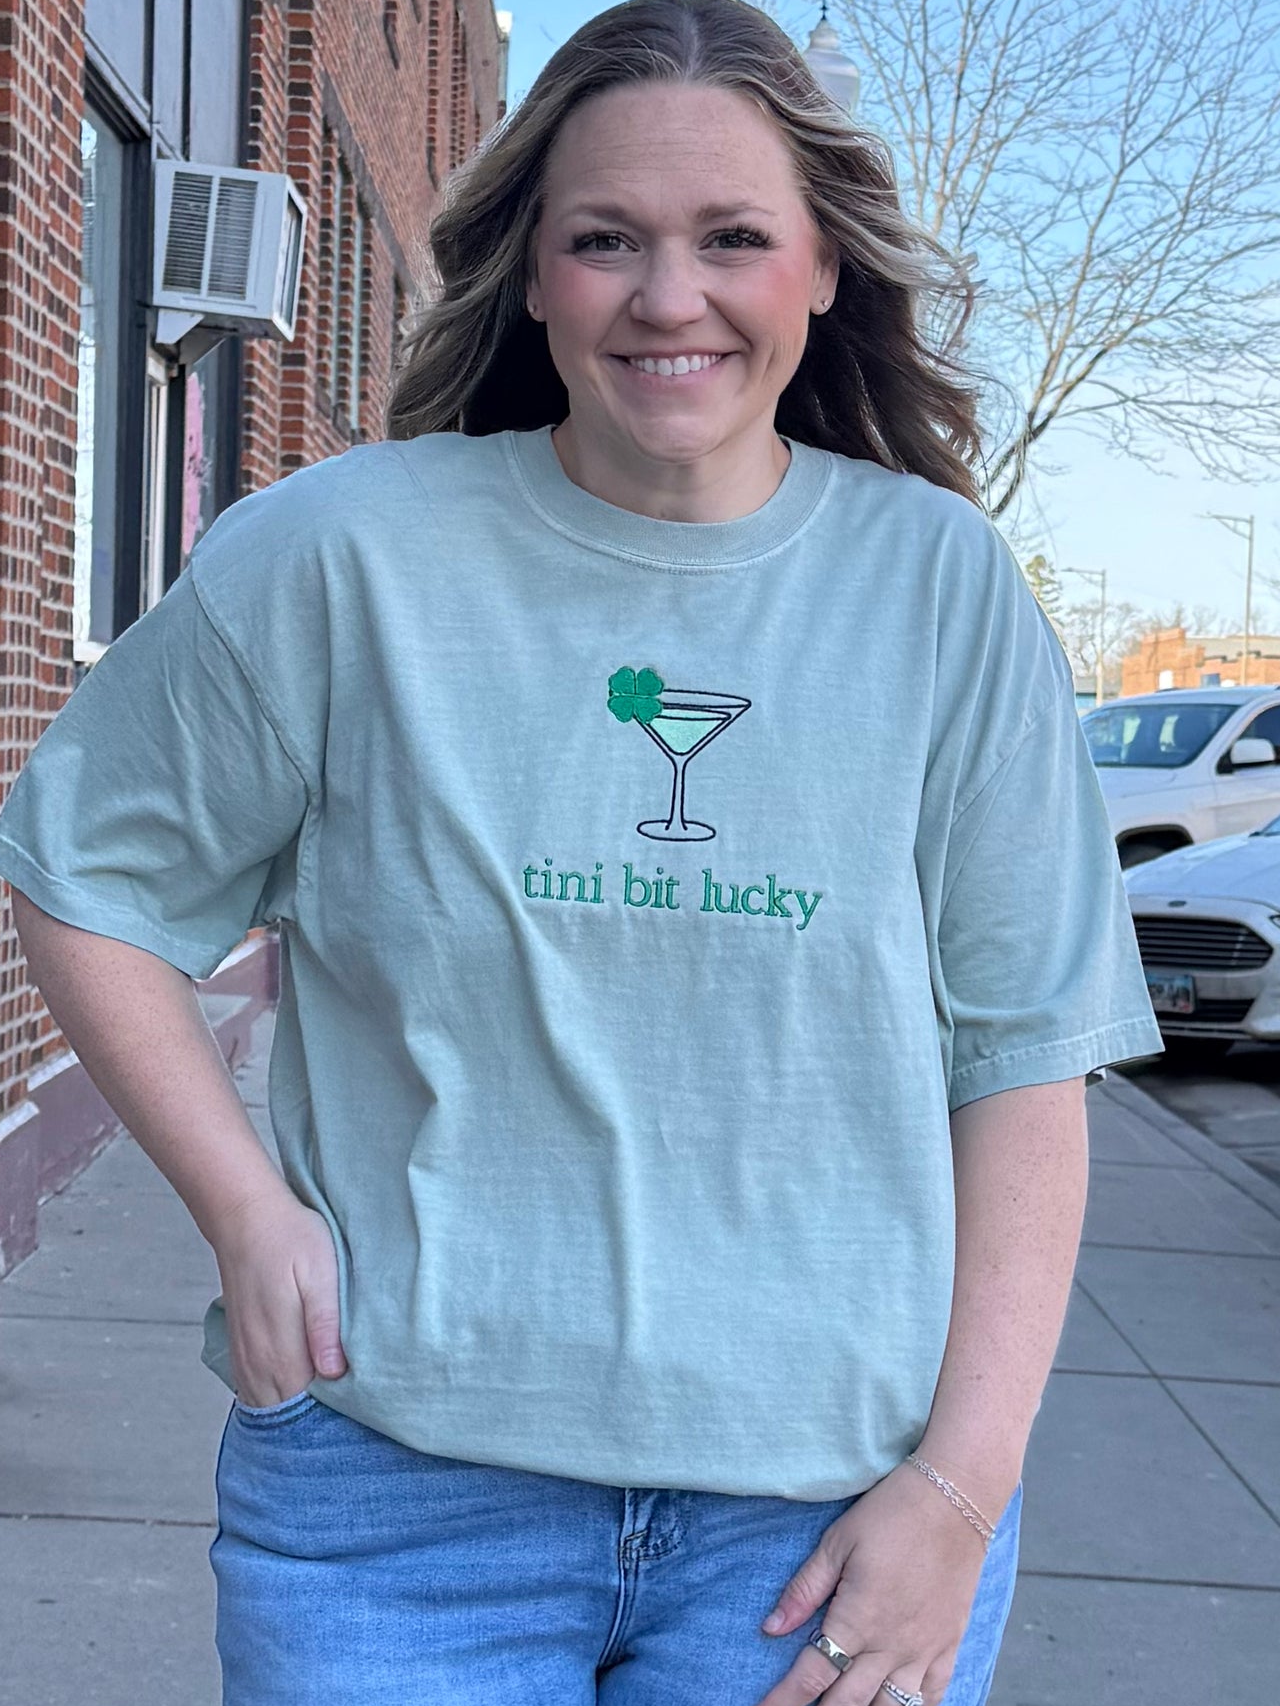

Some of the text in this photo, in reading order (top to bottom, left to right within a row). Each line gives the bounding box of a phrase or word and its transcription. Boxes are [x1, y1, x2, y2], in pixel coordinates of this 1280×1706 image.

[522, 858, 824, 930] tini bit lucky
